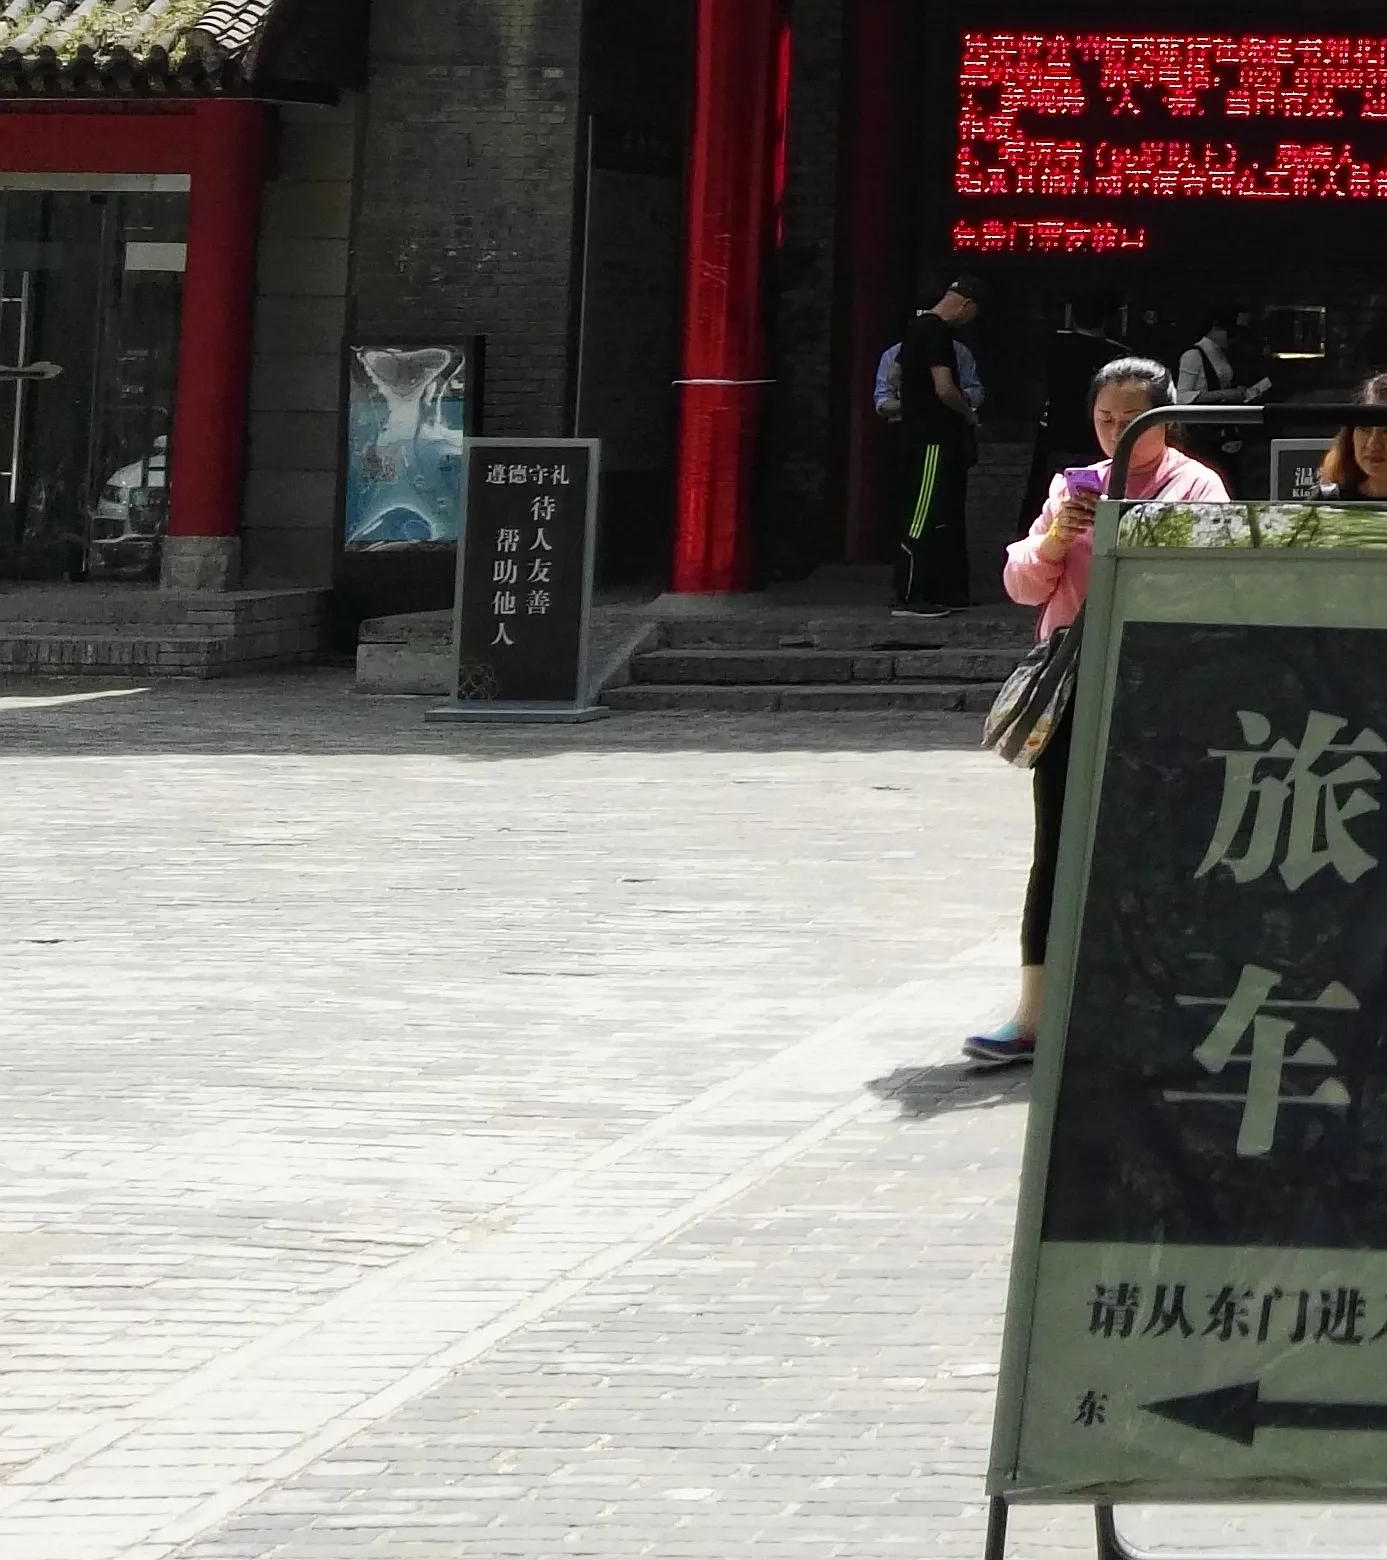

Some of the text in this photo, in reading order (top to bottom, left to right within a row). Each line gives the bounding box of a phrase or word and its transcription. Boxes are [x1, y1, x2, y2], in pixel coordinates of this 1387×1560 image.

[485, 463, 570, 486] 遵德守礼
[490, 527, 521, 646] 帮助他人
[526, 495, 558, 615] 待人友善
[1073, 1390, 1109, 1426] 东
